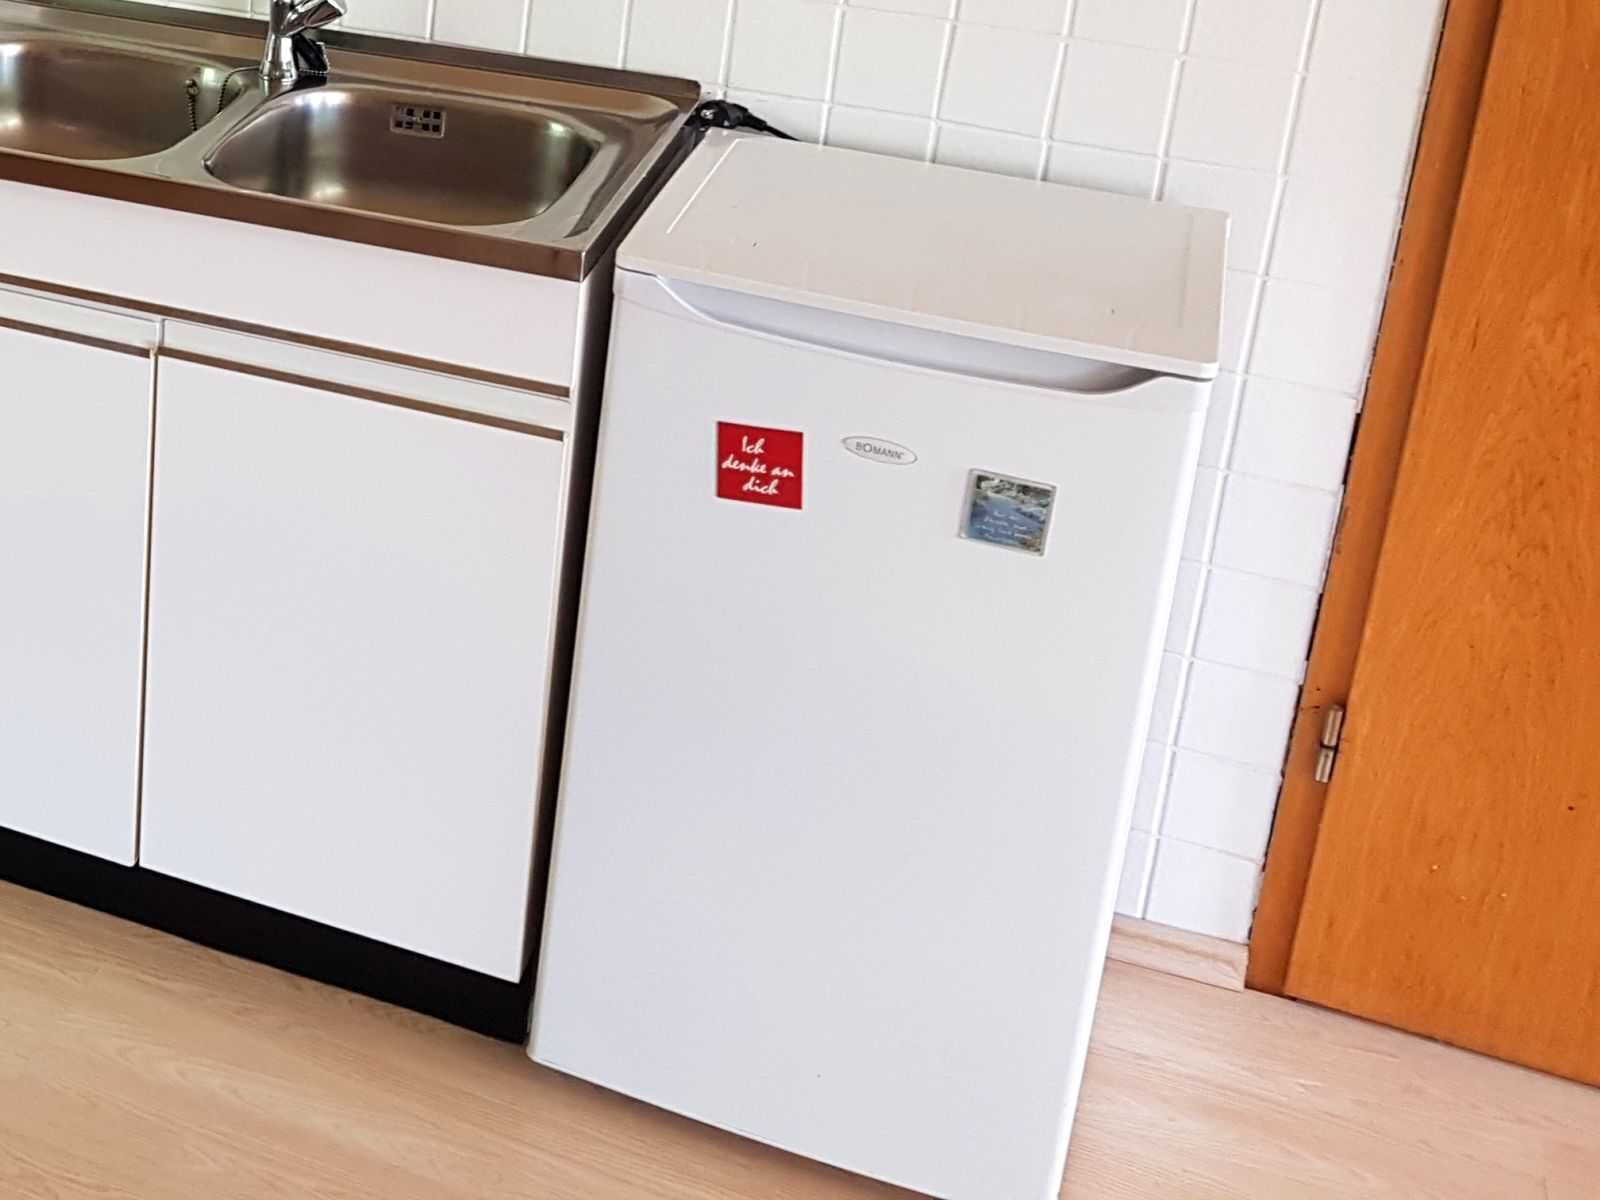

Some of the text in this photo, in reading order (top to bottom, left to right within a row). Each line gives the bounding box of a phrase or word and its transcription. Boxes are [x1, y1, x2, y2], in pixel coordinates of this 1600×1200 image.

[742, 435, 765, 455] Ich
[721, 453, 795, 478] denke an
[742, 476, 779, 496] dich
